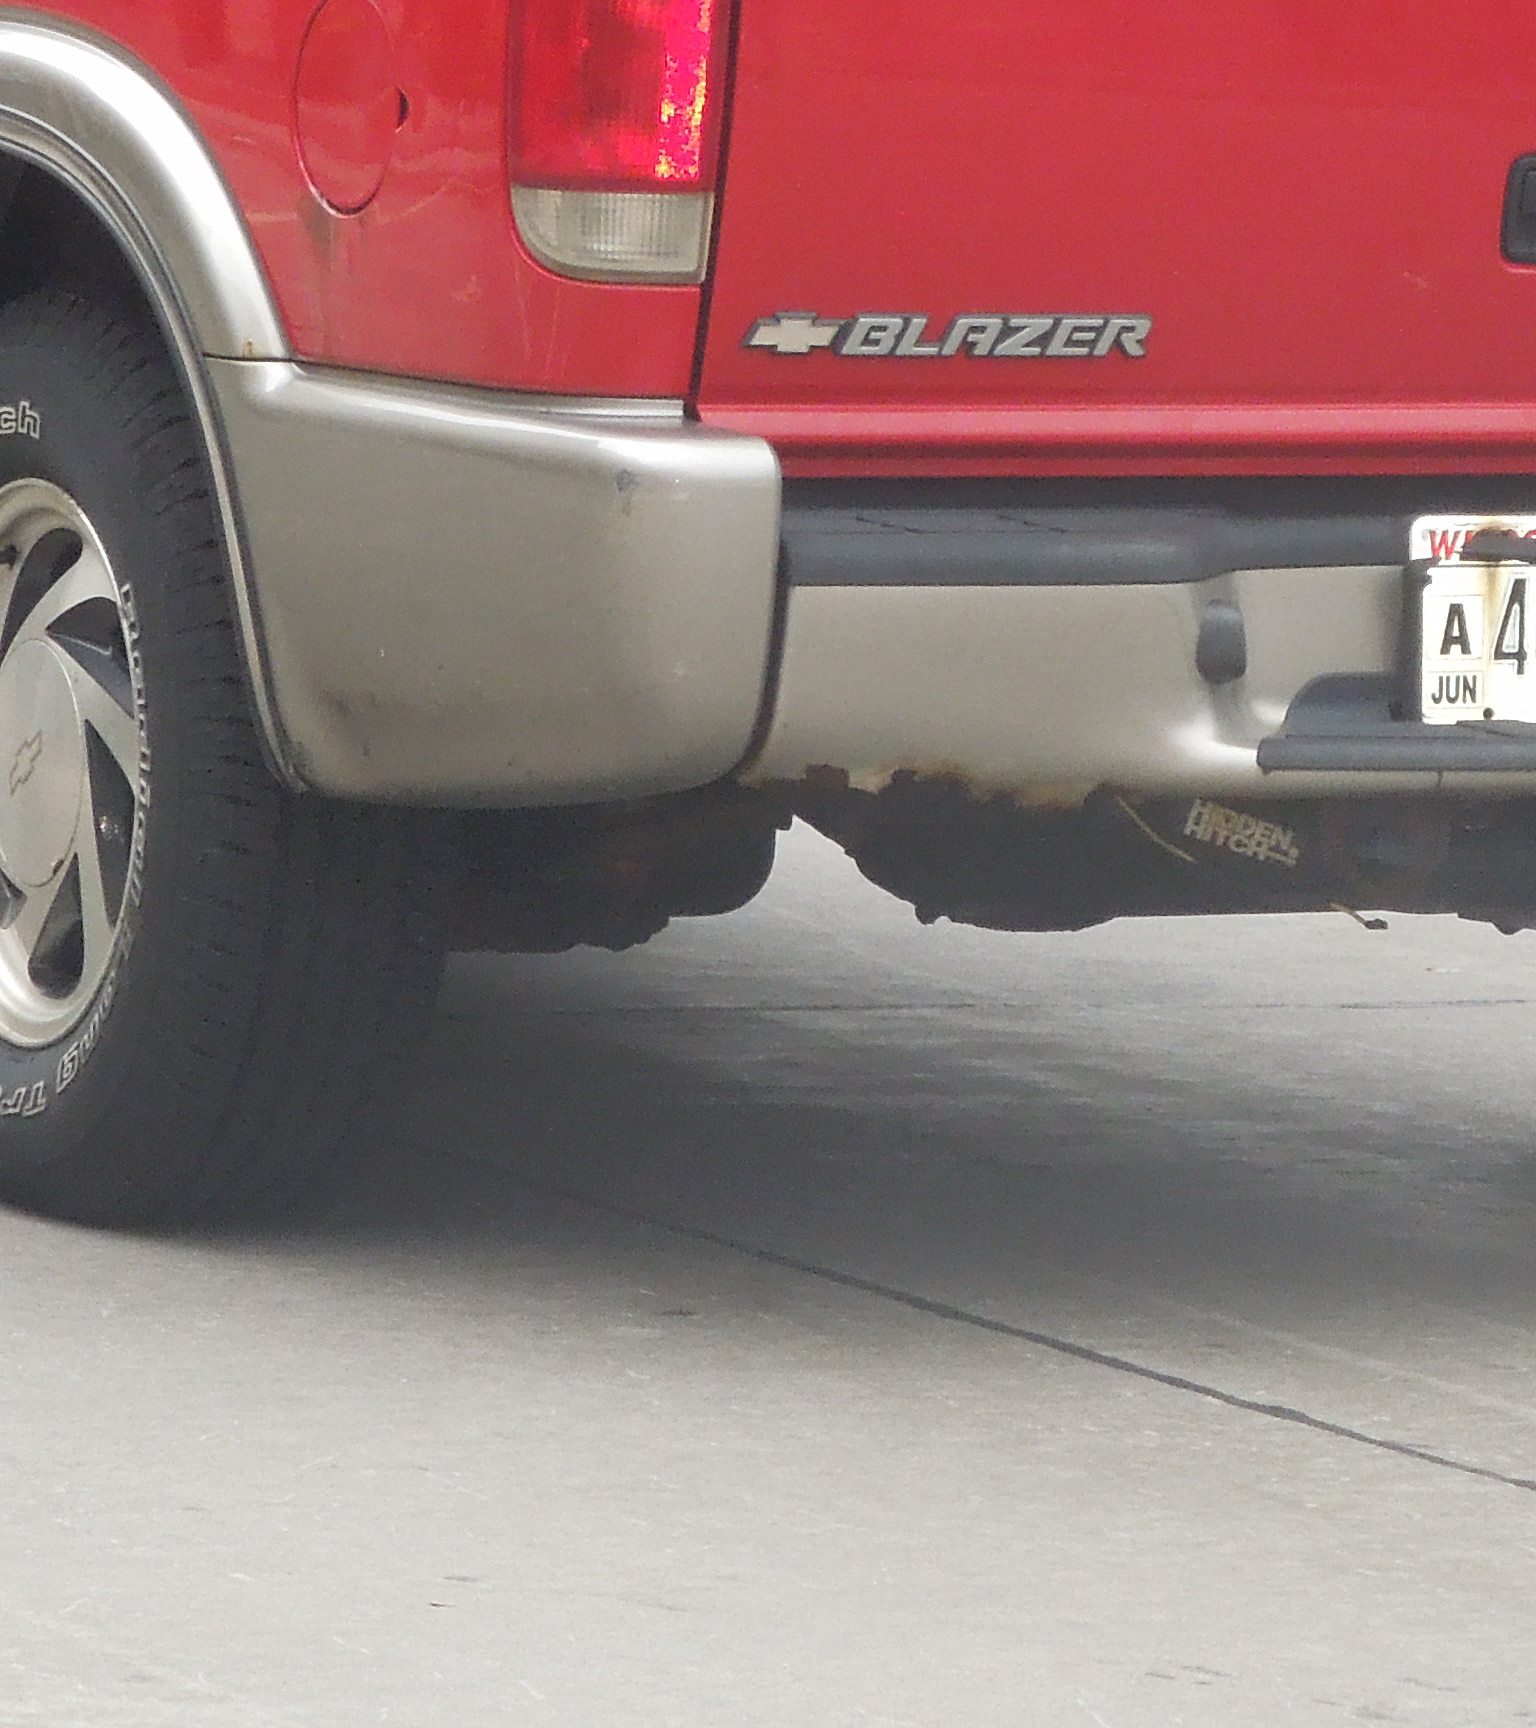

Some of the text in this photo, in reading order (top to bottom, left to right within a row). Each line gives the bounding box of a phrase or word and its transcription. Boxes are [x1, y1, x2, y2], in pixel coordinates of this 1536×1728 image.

[838, 312, 1153, 358] BLAZER
[1438, 602, 1473, 656] A
[1430, 676, 1478, 706] JUN
